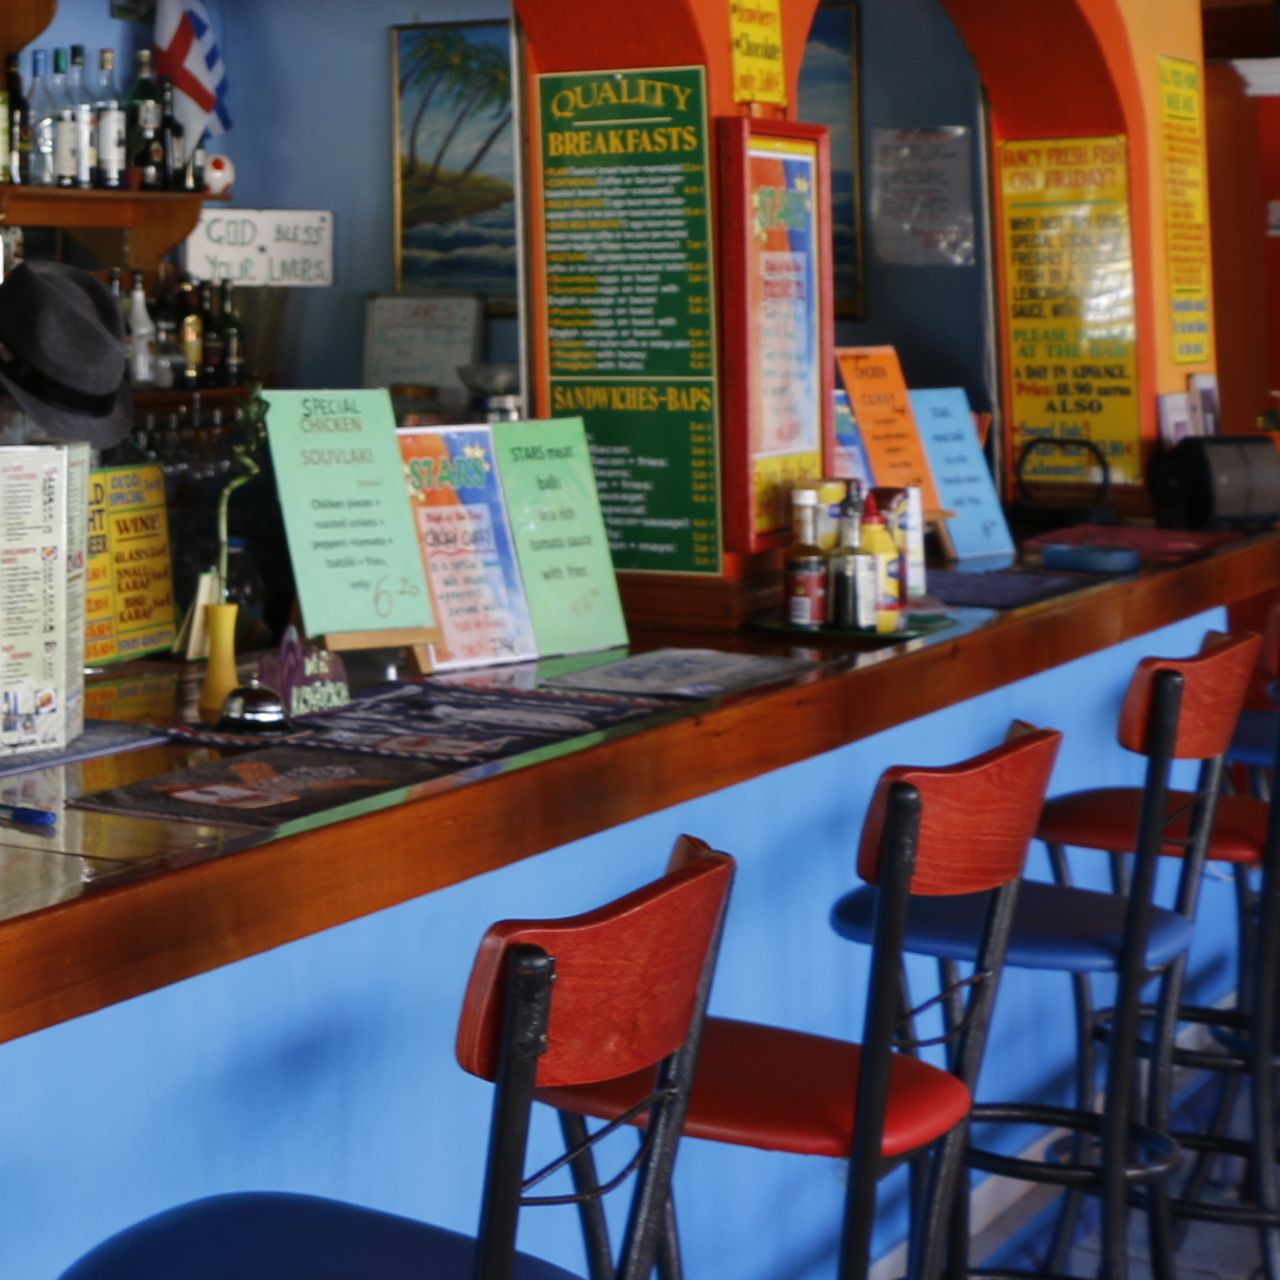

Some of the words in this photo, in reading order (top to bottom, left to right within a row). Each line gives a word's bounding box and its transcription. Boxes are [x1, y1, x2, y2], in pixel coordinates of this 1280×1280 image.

[550, 79, 693, 119] QUALITY
[548, 127, 698, 157] BREAKFASTS
[206, 218, 257, 245] GOD
[302, 398, 361, 416] SPECIAL
[300, 418, 362, 433] CHICKEN
[301, 449, 374, 465] SOUVLAKI
[410, 459, 486, 489] STARS
[116, 514, 160, 535] WINE
